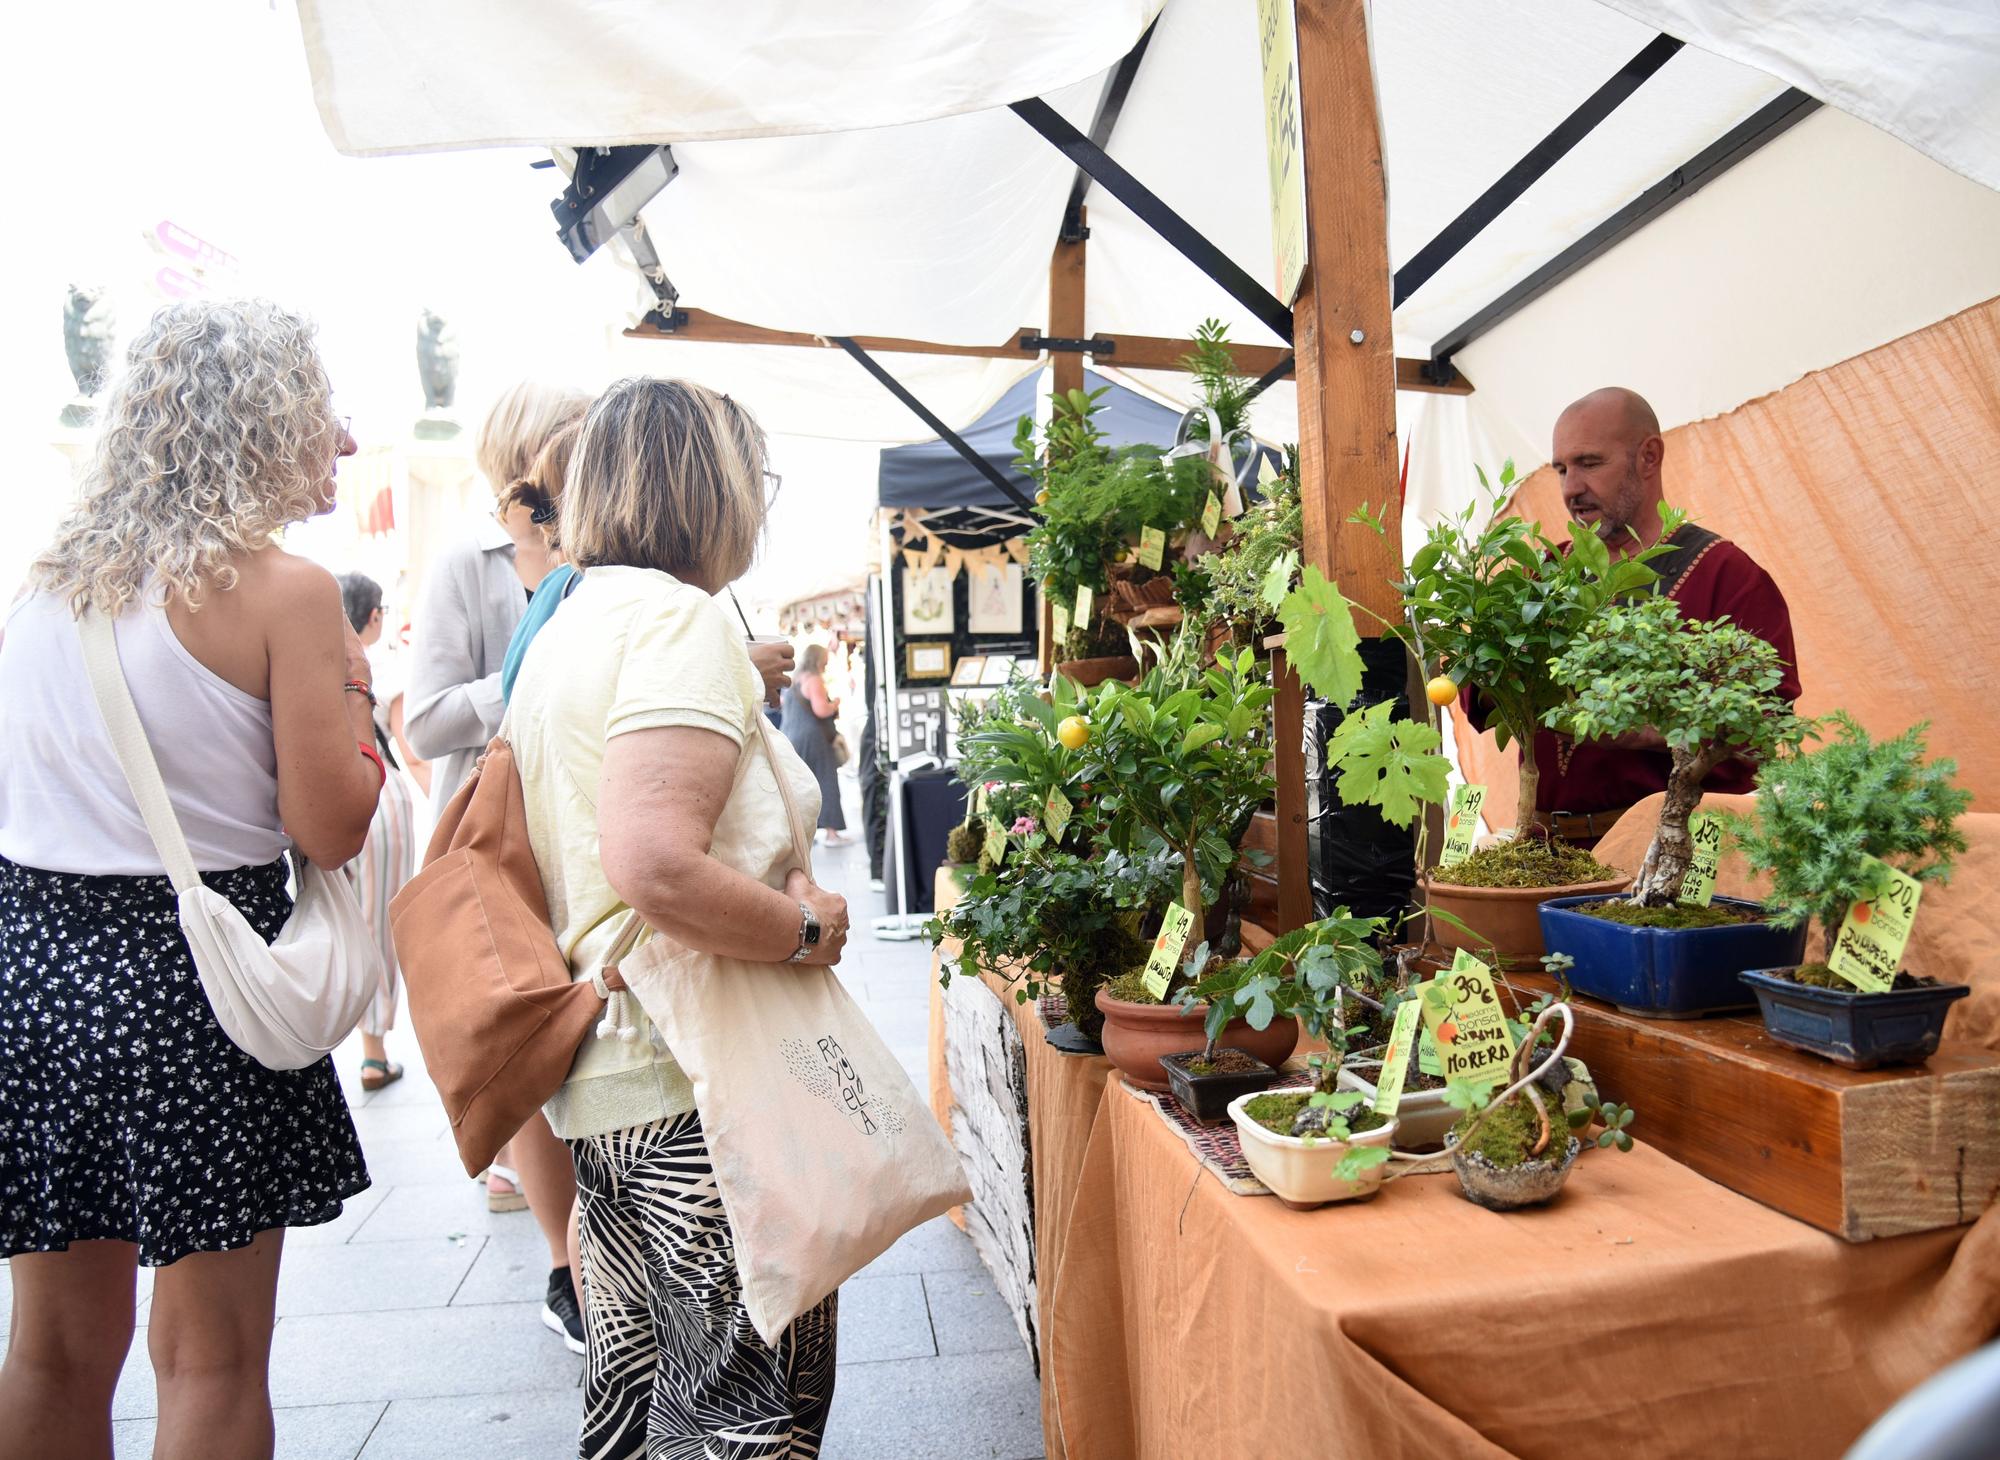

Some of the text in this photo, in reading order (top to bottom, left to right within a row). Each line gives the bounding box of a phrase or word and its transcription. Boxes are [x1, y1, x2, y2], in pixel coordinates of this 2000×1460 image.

[1453, 975, 1494, 1005] 30€
[1459, 1014, 1500, 1032] bonsai
[1448, 1044, 1510, 1074] MORERA
